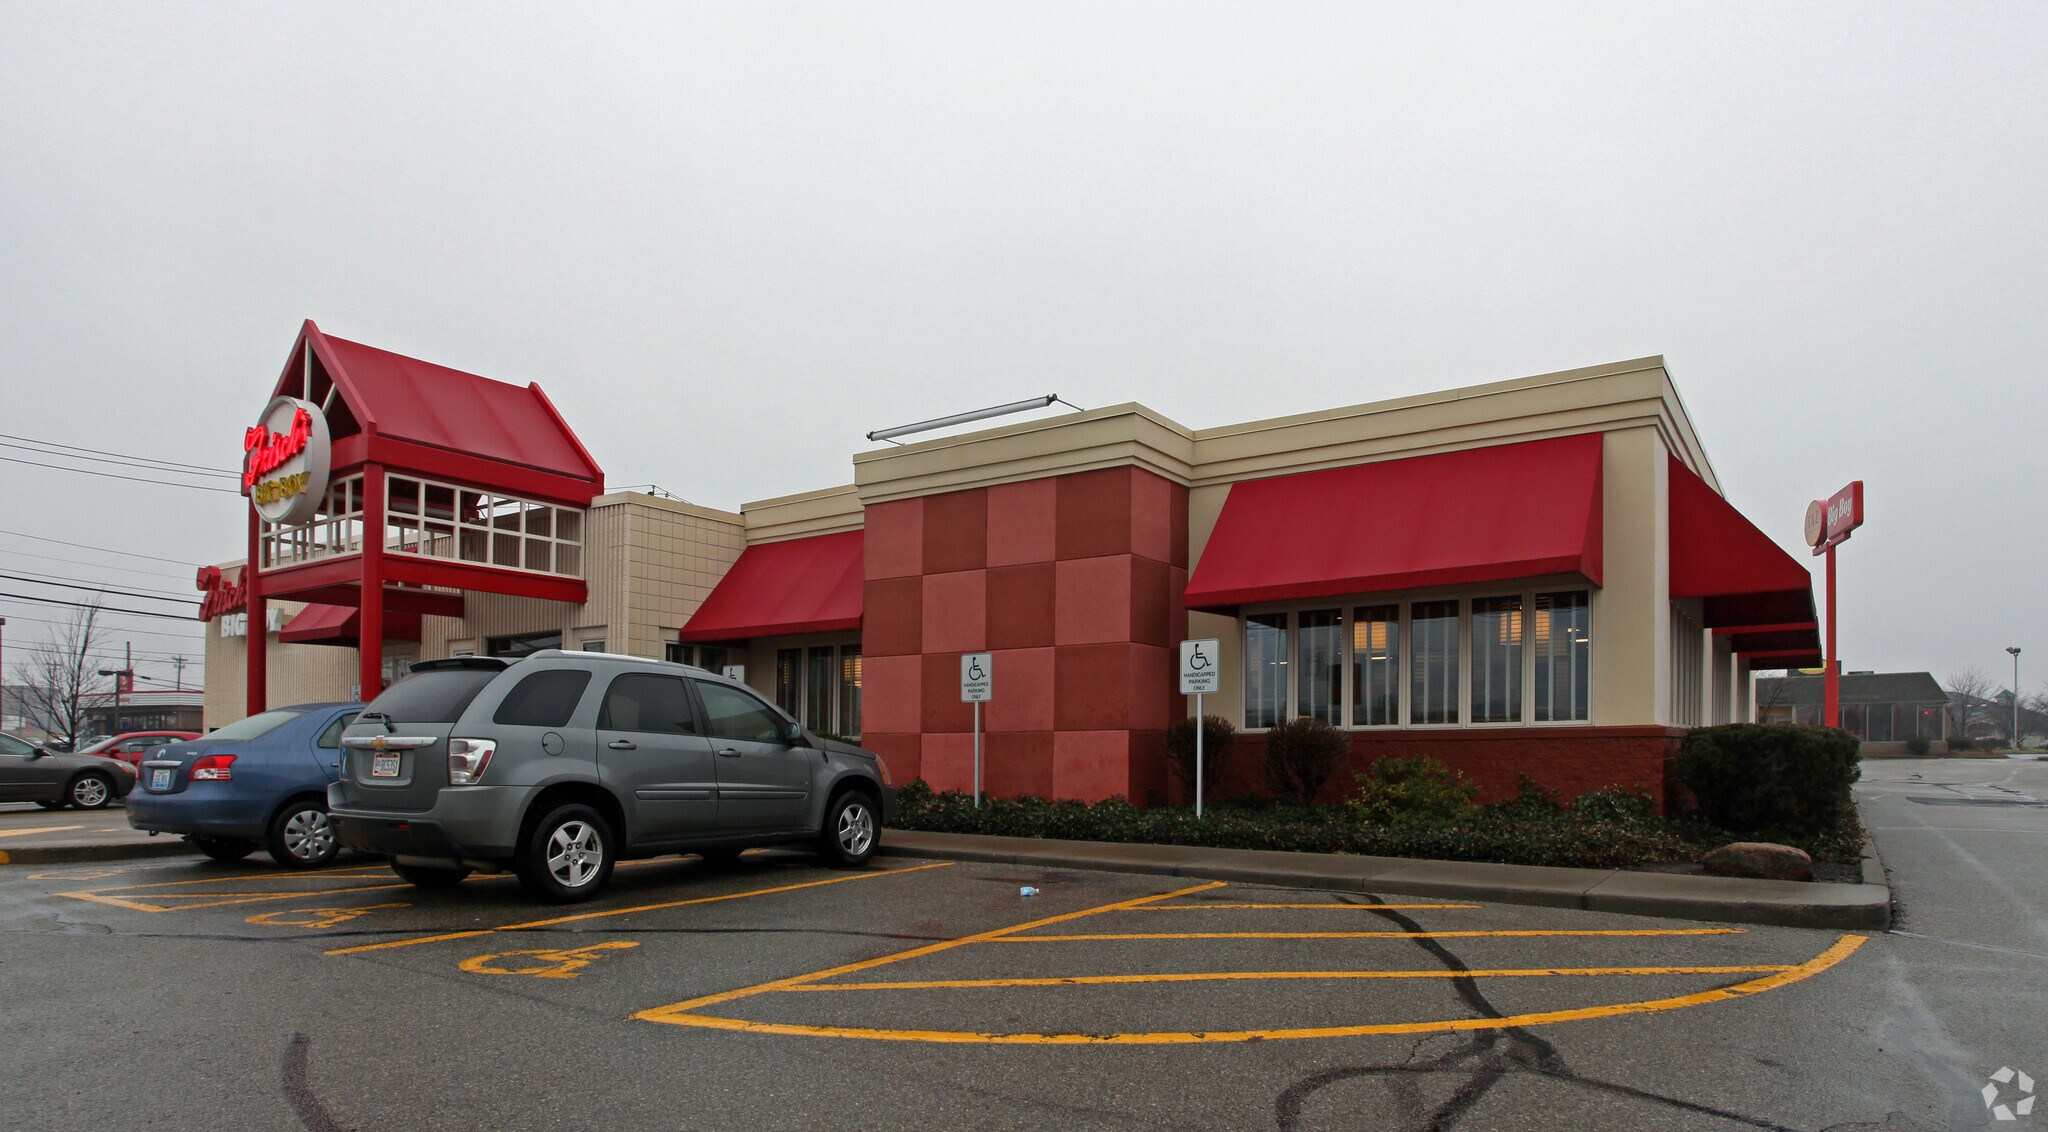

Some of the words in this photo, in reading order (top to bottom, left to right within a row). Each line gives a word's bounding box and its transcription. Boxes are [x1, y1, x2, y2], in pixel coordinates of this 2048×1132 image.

[256, 480, 280, 505] BIG
[280, 471, 311, 498] BOY
[1827, 504, 1839, 528] Big
[1839, 497, 1853, 518] Boy
[221, 612, 248, 638] BIG
